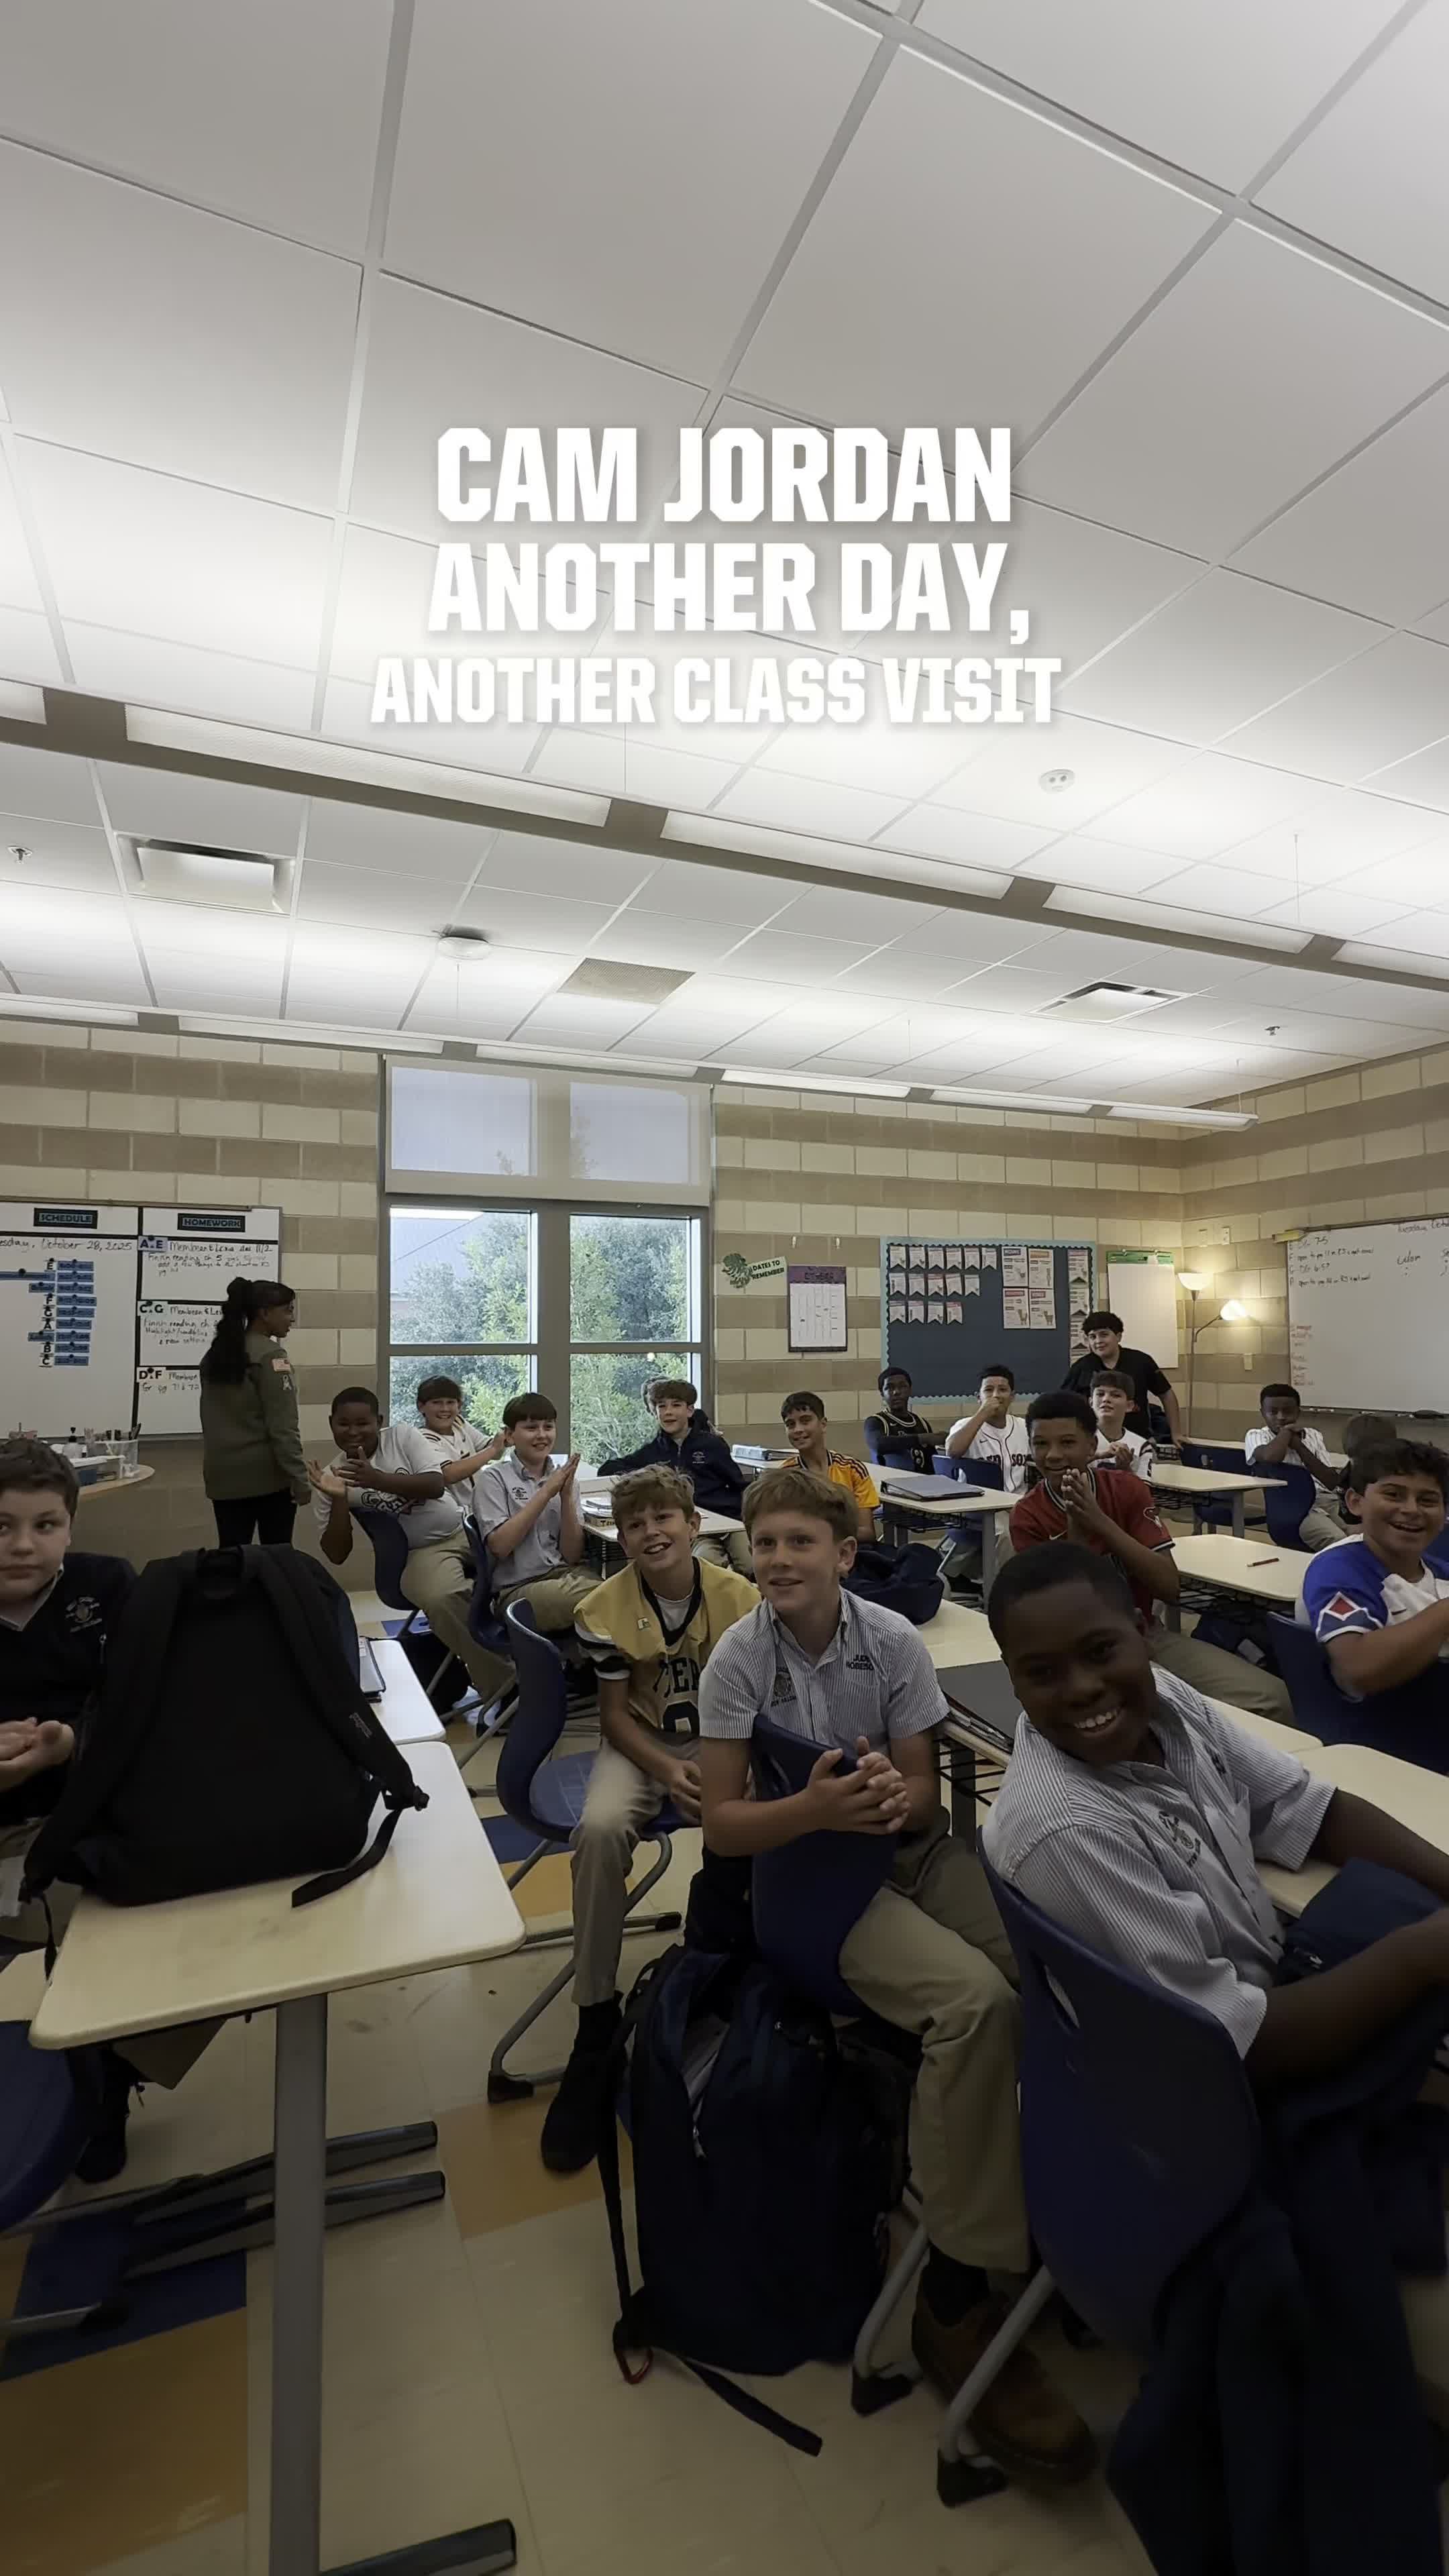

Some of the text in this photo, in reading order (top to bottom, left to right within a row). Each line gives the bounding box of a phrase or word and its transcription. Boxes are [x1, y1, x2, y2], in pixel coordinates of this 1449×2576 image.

[40, 1213, 92, 1223] SCHEDULE
[184, 1218, 241, 1228] HOMEWORK
[46, 1262, 53, 1270] E
[751, 1267, 785, 1280] REMEMBER
[44, 1345, 52, 1354] B
